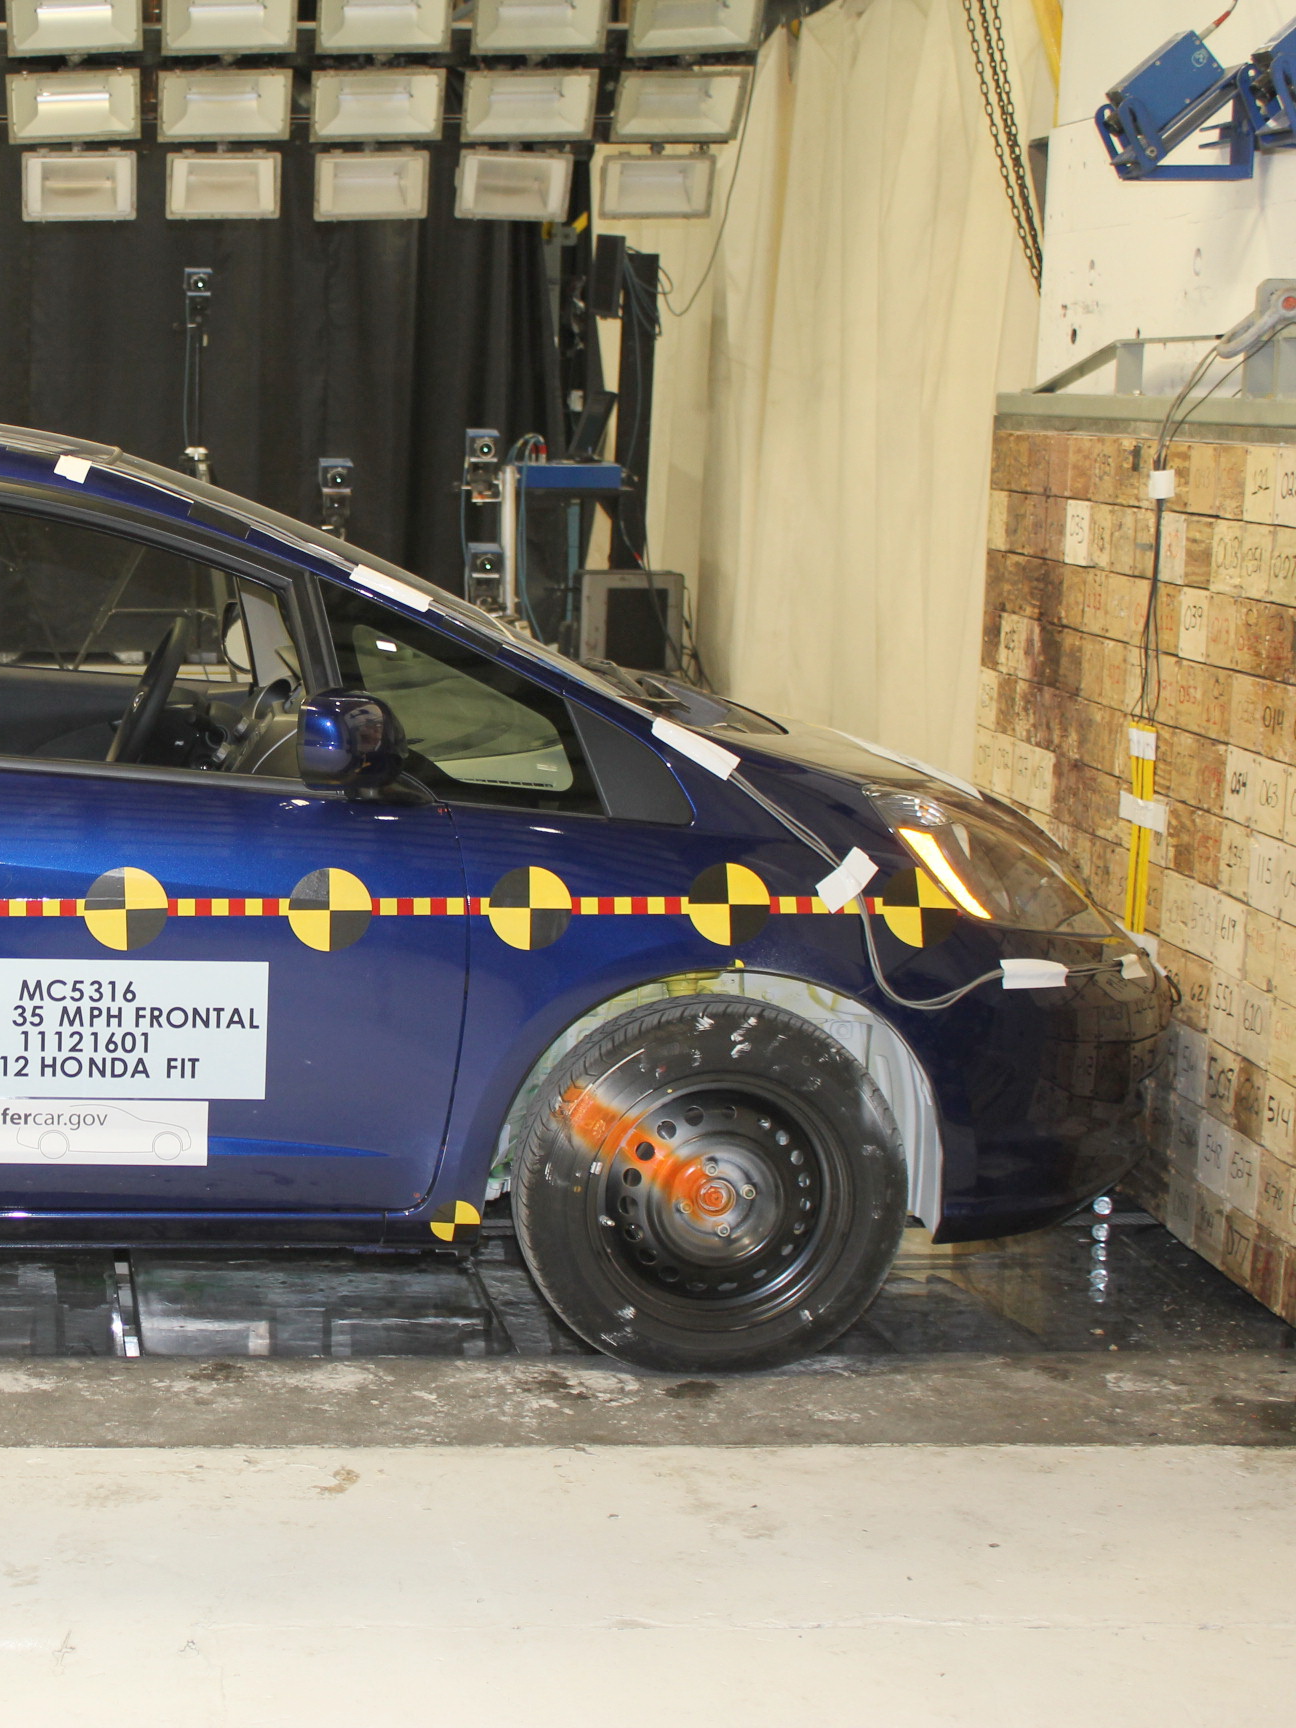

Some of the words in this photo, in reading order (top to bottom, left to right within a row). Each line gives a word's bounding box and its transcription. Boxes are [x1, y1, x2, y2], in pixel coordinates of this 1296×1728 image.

[1184, 604, 1204, 632] 039
[18, 979, 137, 1002] MC5316
[12, 1005, 44, 1027] 35
[59, 1006, 123, 1028] MPH
[135, 1007, 260, 1030] FRONTAL
[20, 1031, 150, 1053] 11121601
[40, 1056, 151, 1079] HONDA
[166, 1057, 200, 1080] FIT
[1267, 1095, 1292, 1138] 514
